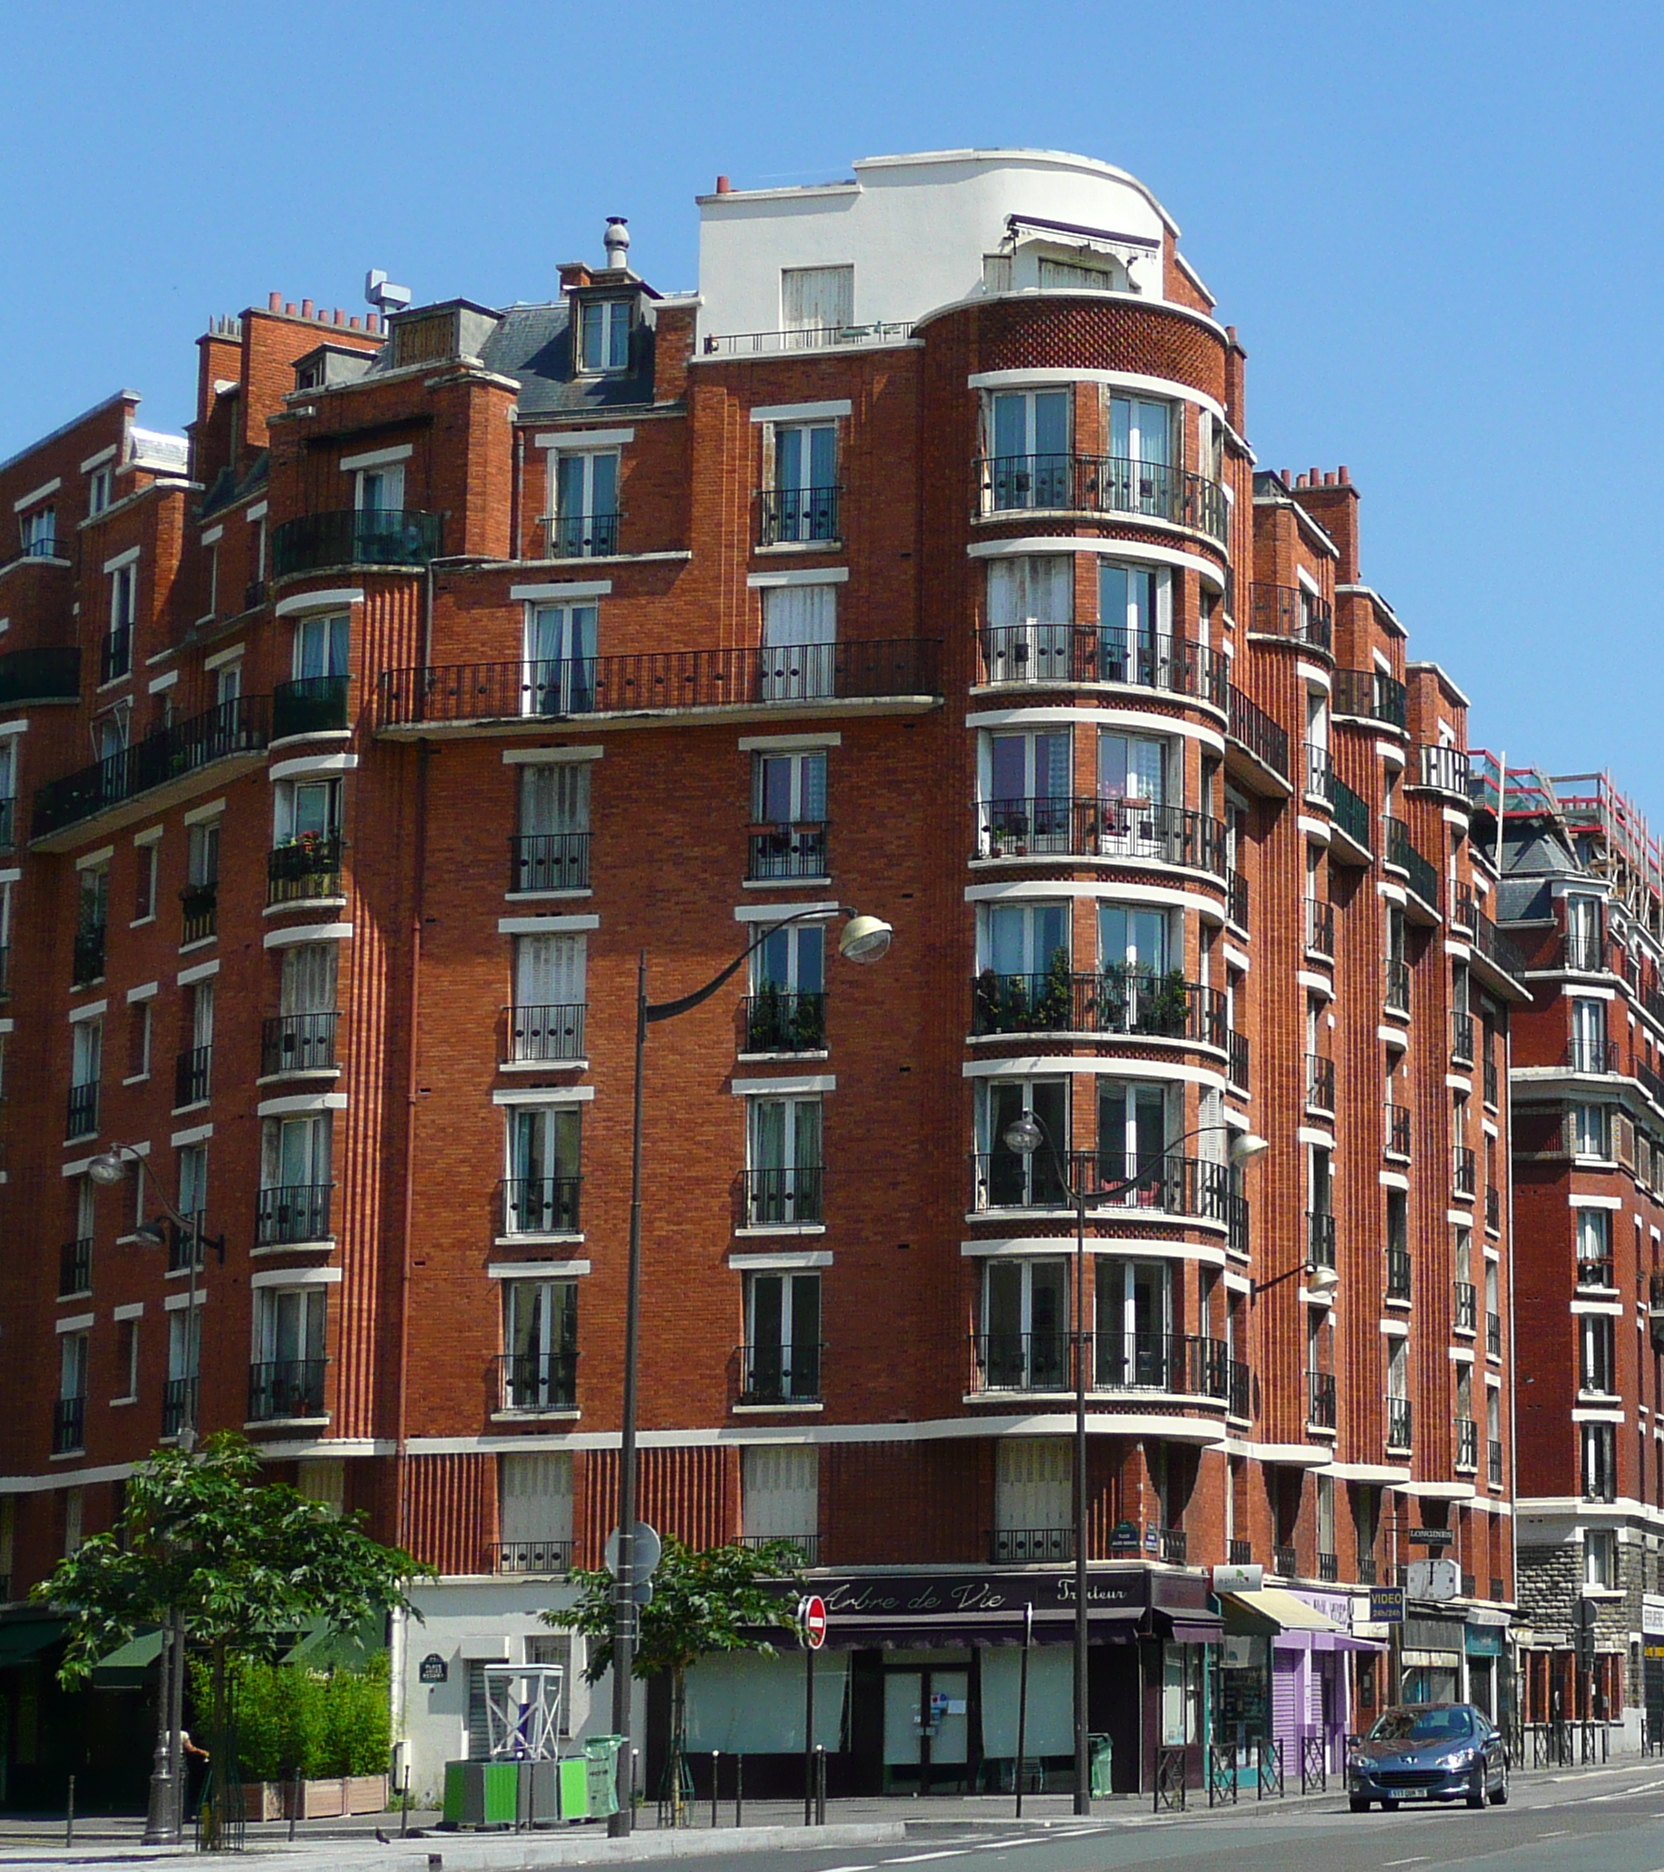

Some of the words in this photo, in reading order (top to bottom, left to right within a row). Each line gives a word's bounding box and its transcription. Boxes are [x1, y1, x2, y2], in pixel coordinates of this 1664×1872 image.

[1410, 1530, 1452, 1539] LONGINES
[907, 1586, 942, 1609] de
[951, 1583, 1006, 1609] Vie
[1057, 1579, 1127, 1600] Triteur
[1371, 1593, 1402, 1604] VIDEO
